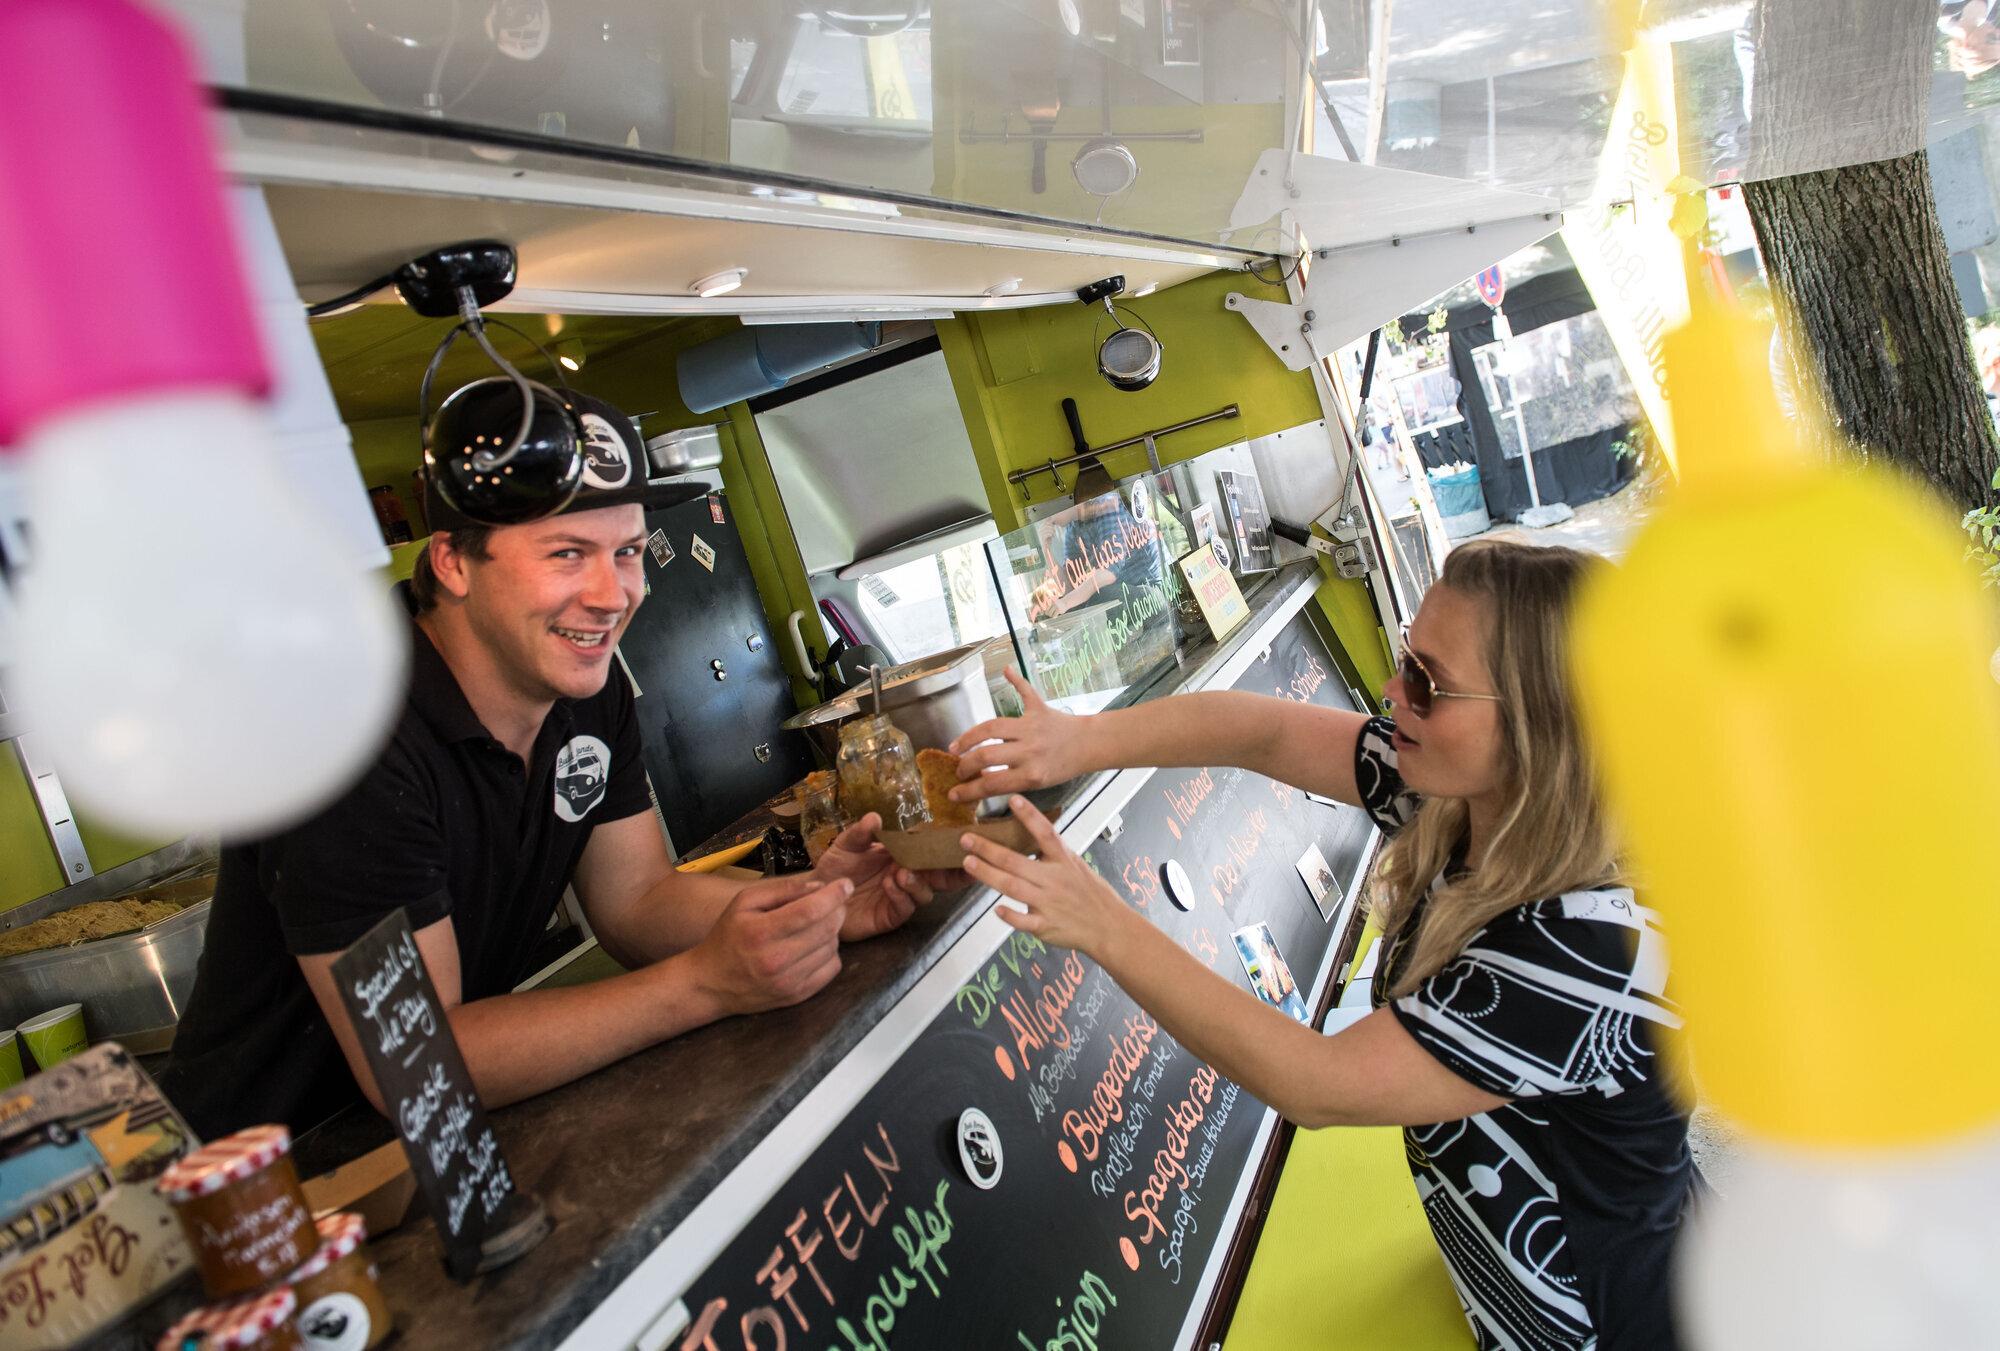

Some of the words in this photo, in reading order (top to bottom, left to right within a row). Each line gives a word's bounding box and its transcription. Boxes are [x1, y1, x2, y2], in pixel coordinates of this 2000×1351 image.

[957, 963, 1001, 1029] Die
[1062, 1009, 1159, 1162] Burgerdatsc
[1091, 1101, 1153, 1199] Rindfleisch,
[1160, 1188, 1202, 1285] Spargel,
[1187, 1143, 1214, 1189] Sauce
